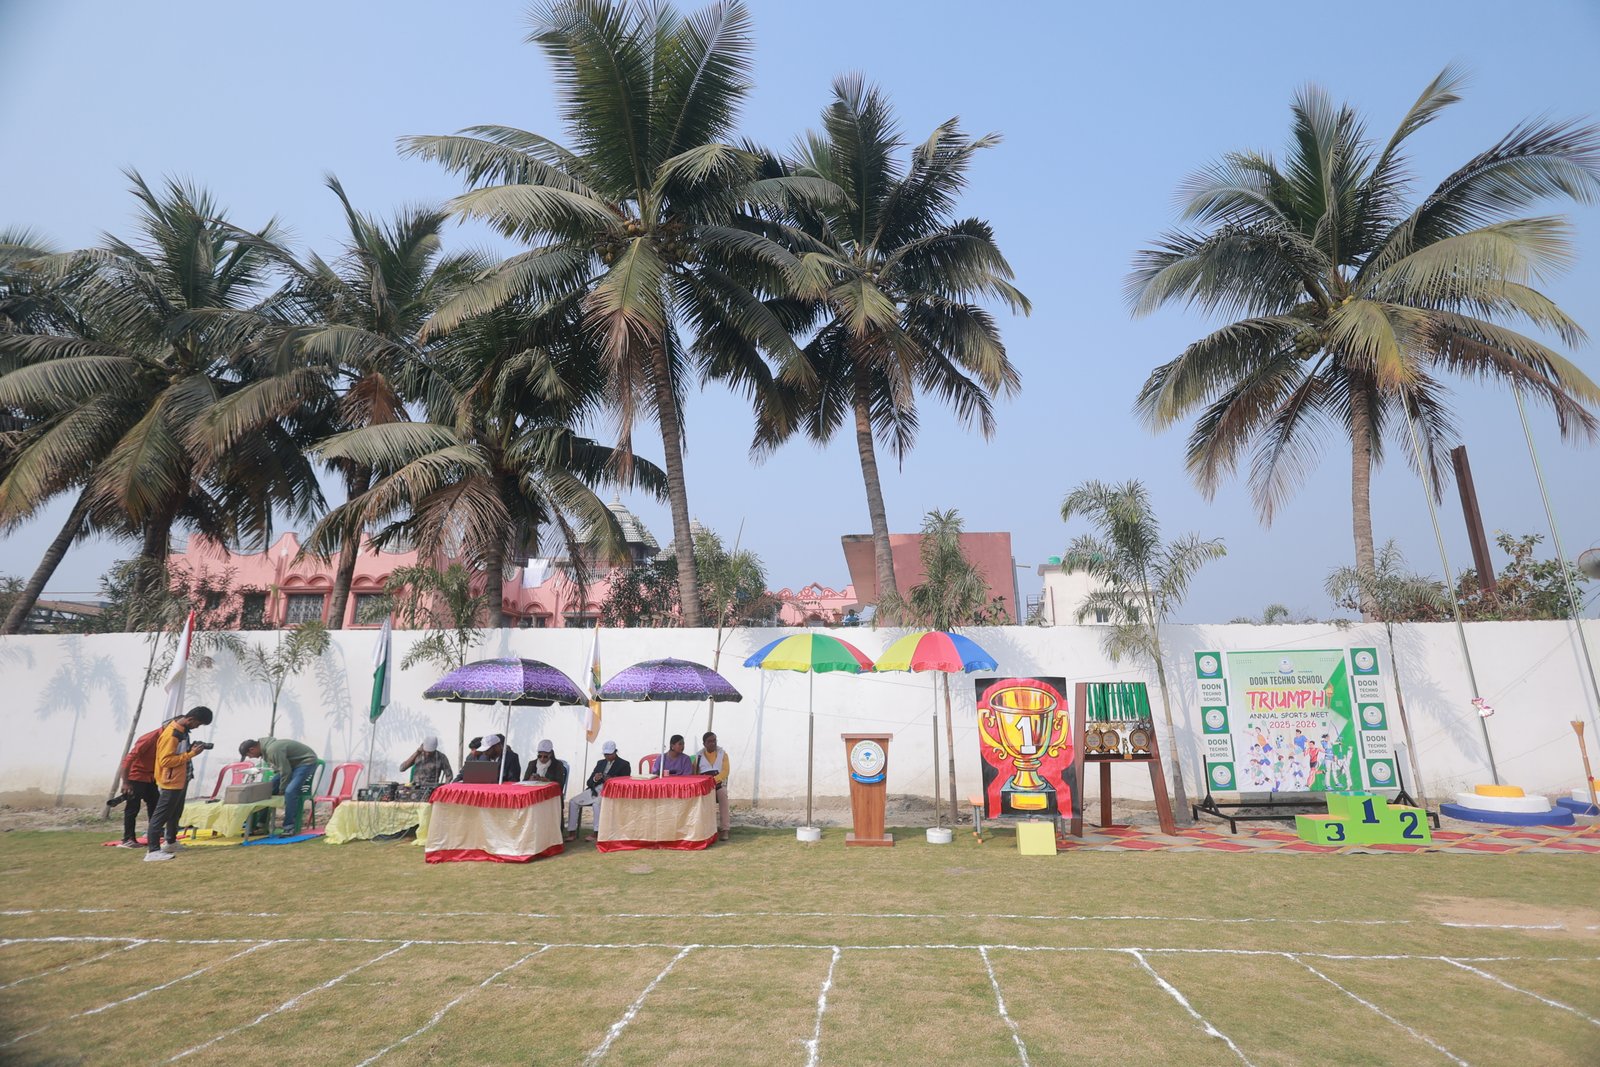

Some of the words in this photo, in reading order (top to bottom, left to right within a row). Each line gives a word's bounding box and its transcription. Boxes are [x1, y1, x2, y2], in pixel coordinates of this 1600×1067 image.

[1250, 677, 1268, 686] DOON
[1270, 676, 1296, 685] TECHNO
[1298, 675, 1324, 684] SCHOOL
[1246, 690, 1325, 710] TRIUMPH
[1270, 721, 1316, 729] 2025-2026
[1015, 716, 1037, 755] 1
[1362, 798, 1380, 824] 1
[1324, 822, 1346, 842] 3
[1400, 812, 1424, 839] 2
